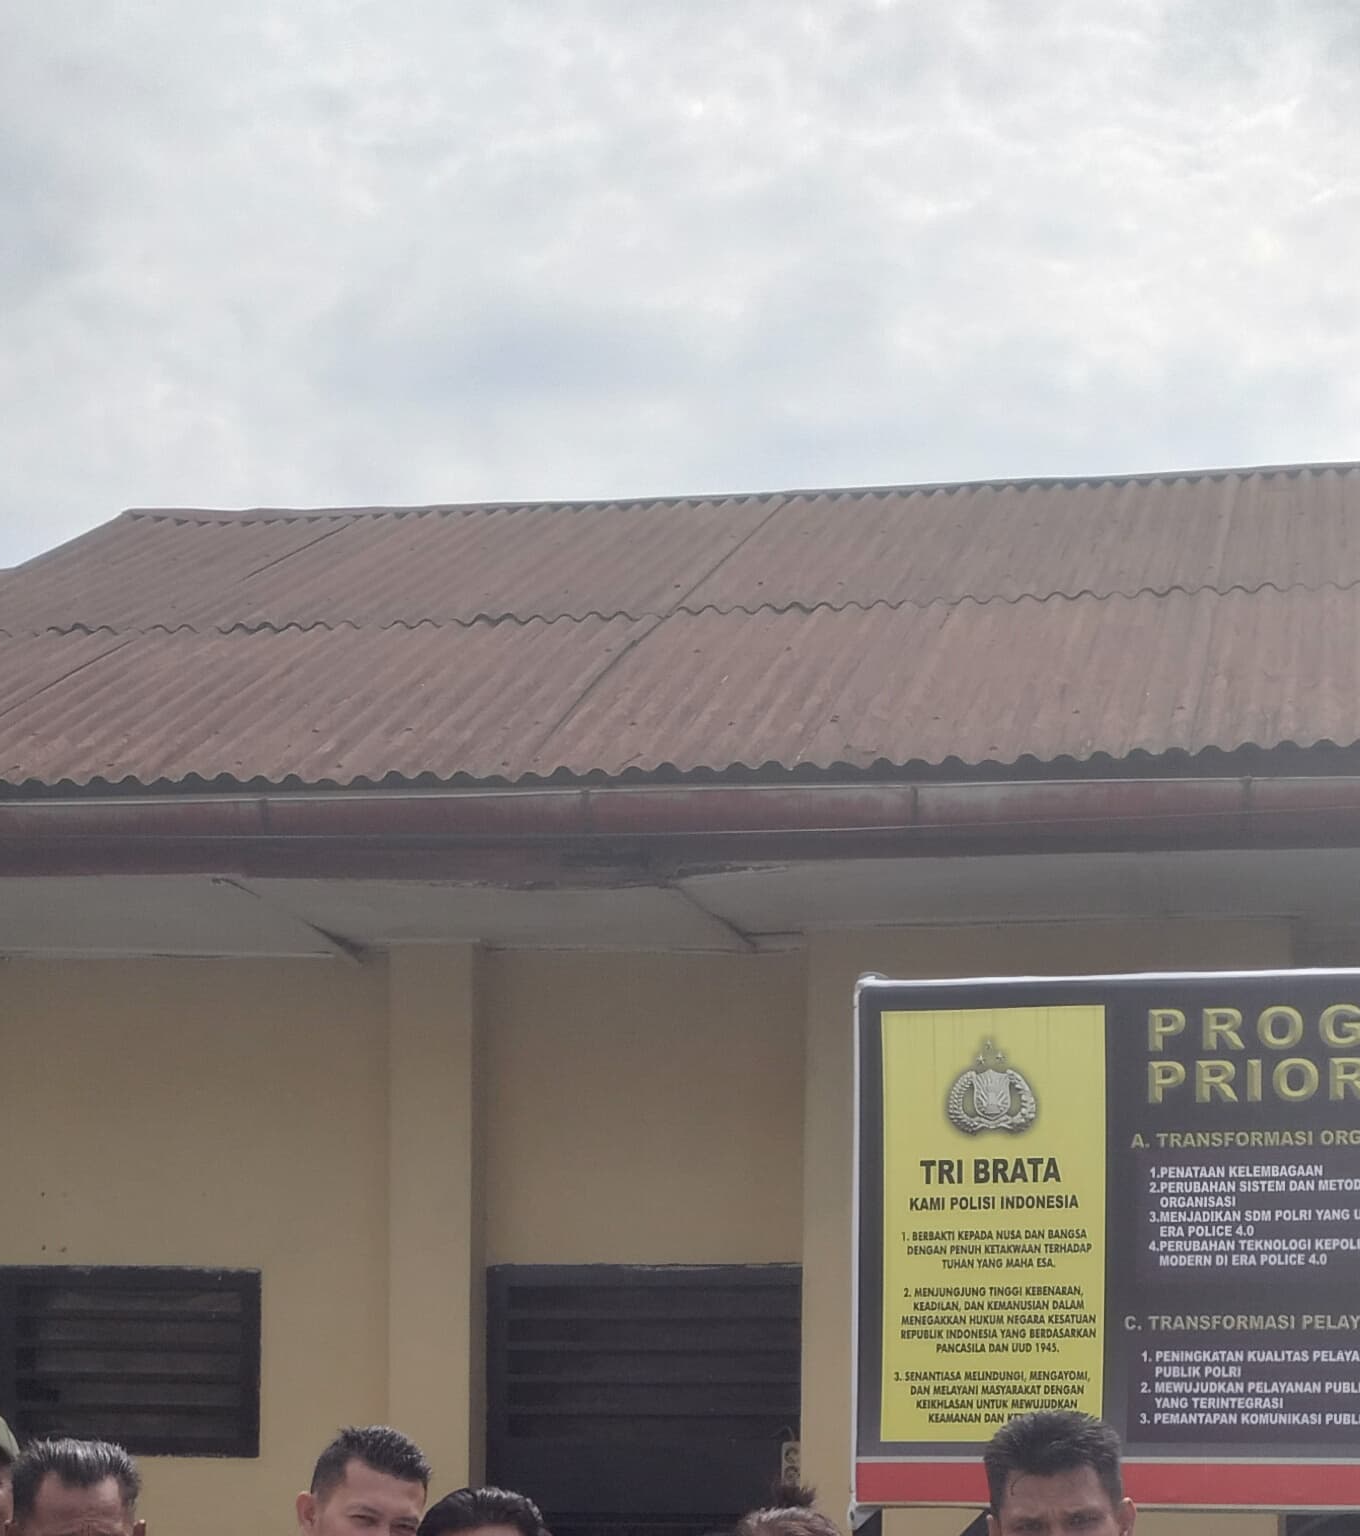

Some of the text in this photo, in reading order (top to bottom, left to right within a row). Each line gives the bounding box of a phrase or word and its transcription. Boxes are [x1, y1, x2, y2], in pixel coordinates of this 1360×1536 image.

[1131, 1133, 1150, 1149] A.
[1157, 1131, 1313, 1148] TRANSFORMASI
[920, 1158, 1060, 1184] TRI BRATA
[1229, 1164, 1323, 1177] KELEMBAGAAN
[1239, 1179, 1285, 1193] SISTEM
[1289, 1179, 1314, 1192] DAN
[910, 1195, 1078, 1211] KAMI POLISI INDONESIA
[1160, 1195, 1236, 1209] ORGANISASI
[1245, 1209, 1273, 1222] SDM
[1275, 1209, 1312, 1221] POLRI
[1316, 1208, 1350, 1221] YANG
[902, 1229, 1087, 1240] 1. BERBAKTI KEPADA NUSA DAN BANGSA
[1160, 1224, 1254, 1238] ERA POLICE 4.0
[907, 1243, 1092, 1255] DENGAN PENUH KETAKWAAN TERHADAP
[1239, 1238, 1311, 1252] TEKNOLOGI
[942, 1259, 973, 1268] TUHAN
[977, 1259, 1003, 1268] YANG
[1006, 1259, 1033, 1268] MAHA
[1159, 1252, 1327, 1268] MODERN DI ERA POLICE 4.0
[1124, 1315, 1142, 1330] C.
[1149, 1314, 1294, 1330] TRANSFORMASI
